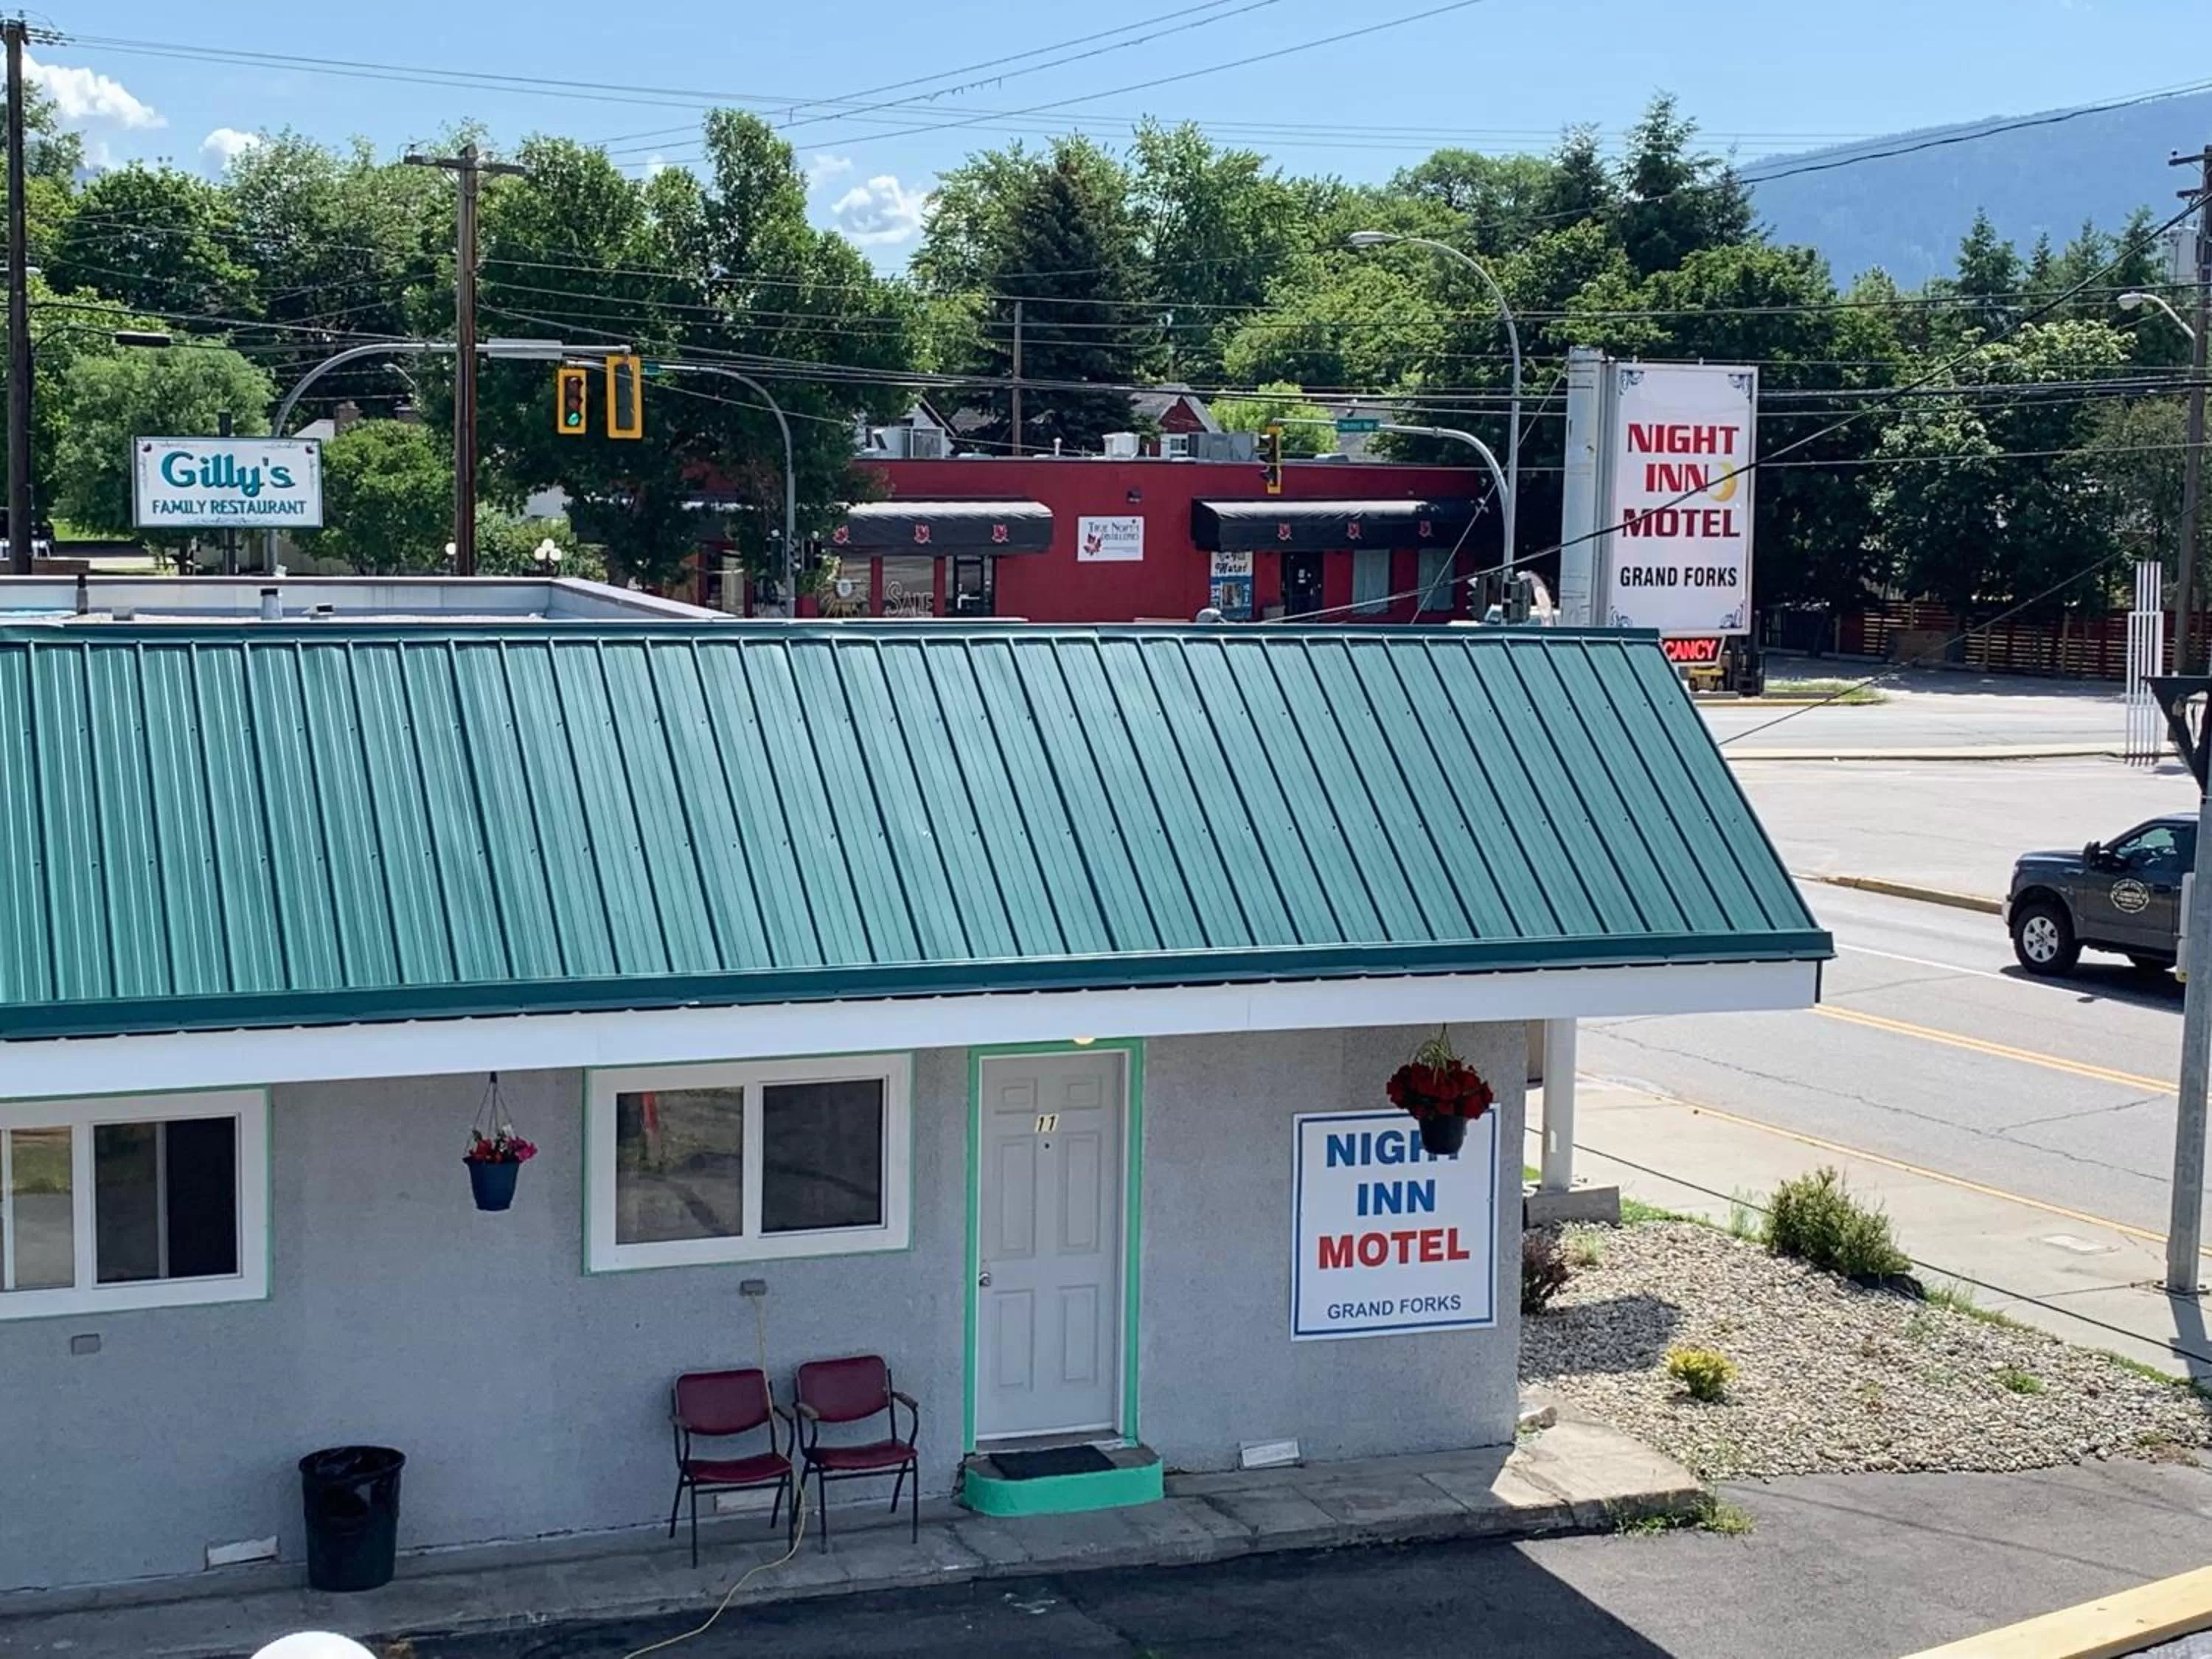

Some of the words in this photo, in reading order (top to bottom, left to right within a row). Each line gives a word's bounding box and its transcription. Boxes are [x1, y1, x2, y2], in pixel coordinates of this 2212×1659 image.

[1627, 423, 1740, 454] NIGHT
[161, 451, 296, 498] Gilly's
[1645, 463, 1709, 492] INN
[152, 499, 207, 514] FAMILY
[210, 499, 307, 514] RESTAURANT
[1622, 507, 1740, 538] MOTEL
[1620, 566, 1677, 588] GRAND
[1684, 566, 1737, 587] FORKS
[885, 580, 934, 617] SALE
[1037, 1116, 1056, 1132] 11
[1326, 1130, 1458, 1167] NIGH
[1357, 1180, 1436, 1216] INN
[1318, 1228, 1470, 1270] MOTEL
[1327, 1299, 1394, 1319] GRAND
[1399, 1295, 1461, 1314] FORKS
